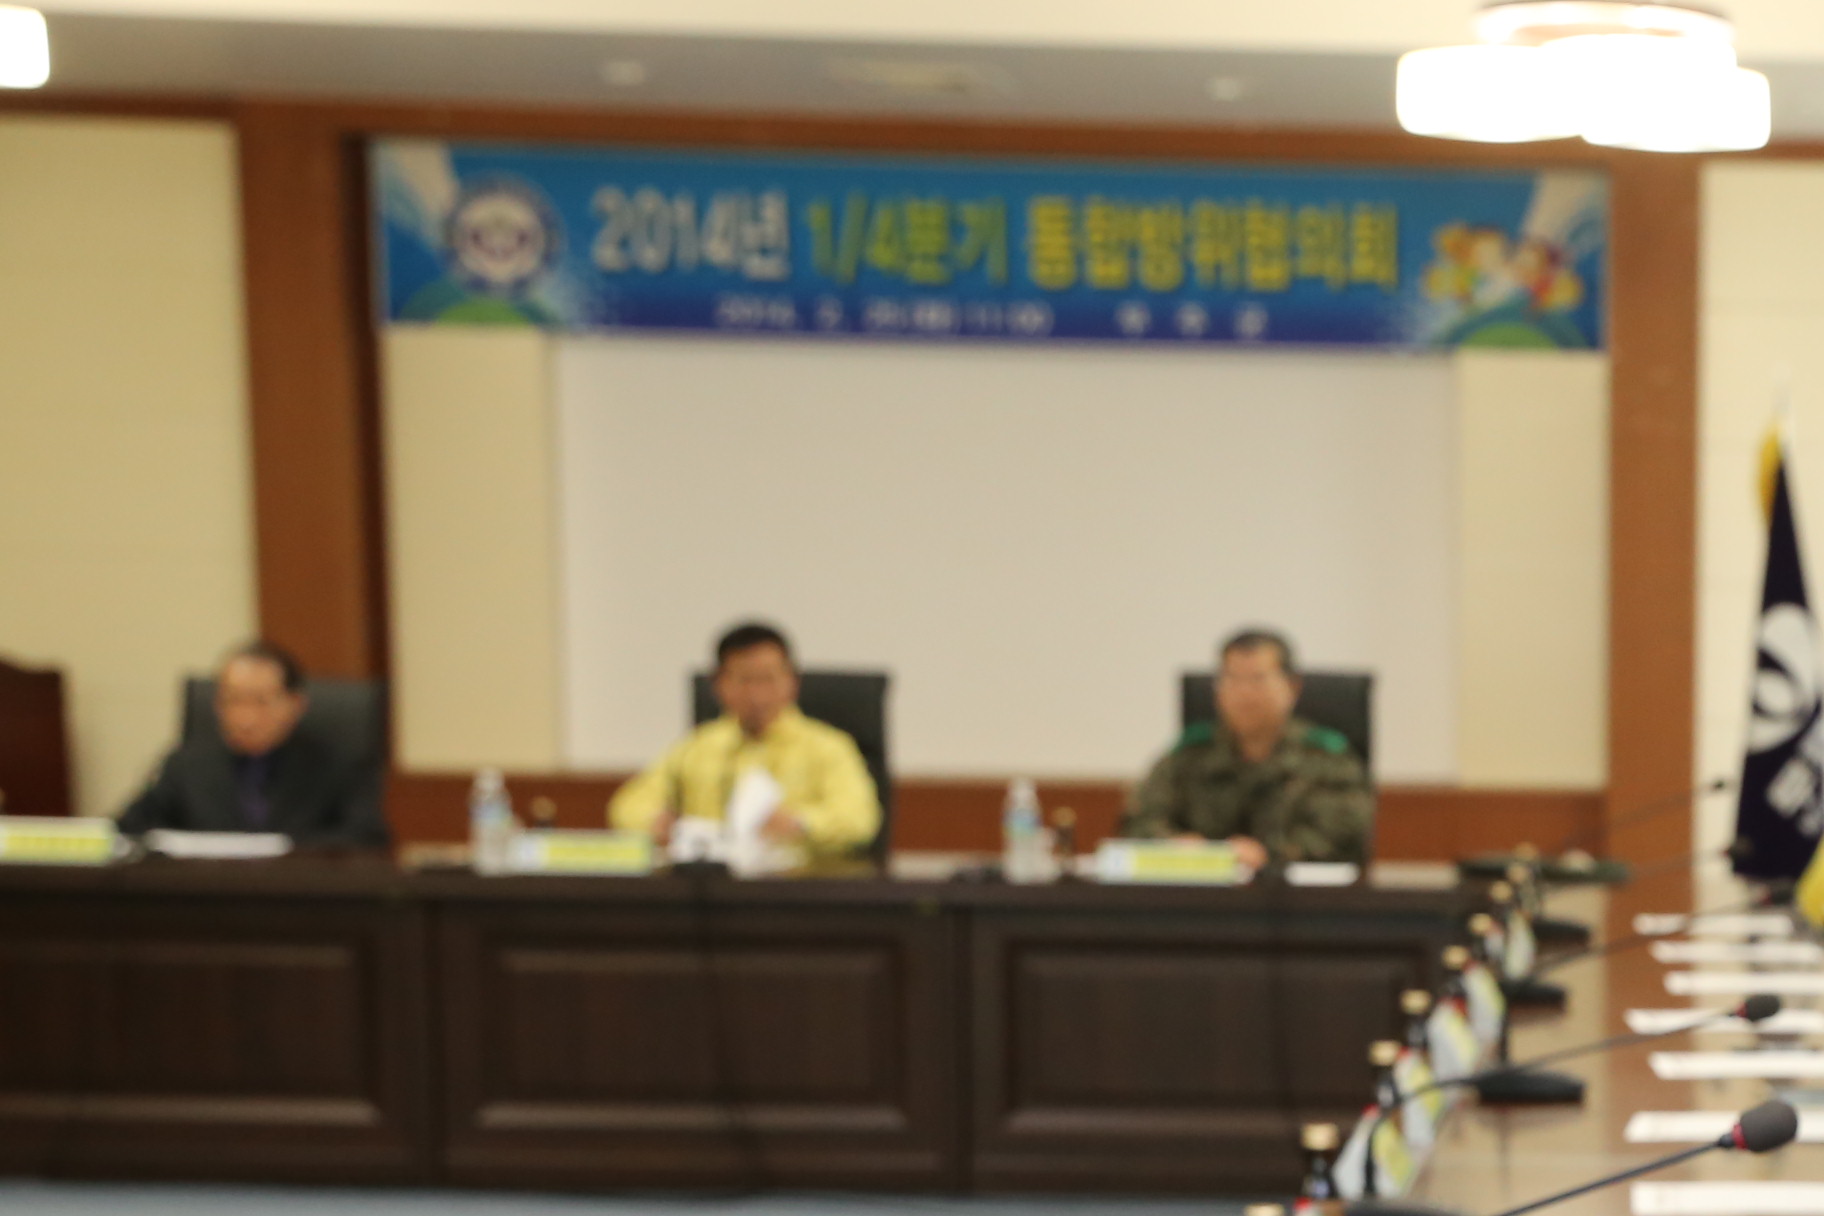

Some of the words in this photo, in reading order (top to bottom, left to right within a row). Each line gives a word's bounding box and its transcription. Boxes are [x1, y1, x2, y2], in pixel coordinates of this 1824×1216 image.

[592, 188, 790, 281] 2014년
[807, 194, 1006, 286] 1/4분기
[1026, 196, 1397, 292] 통합방위협의회
